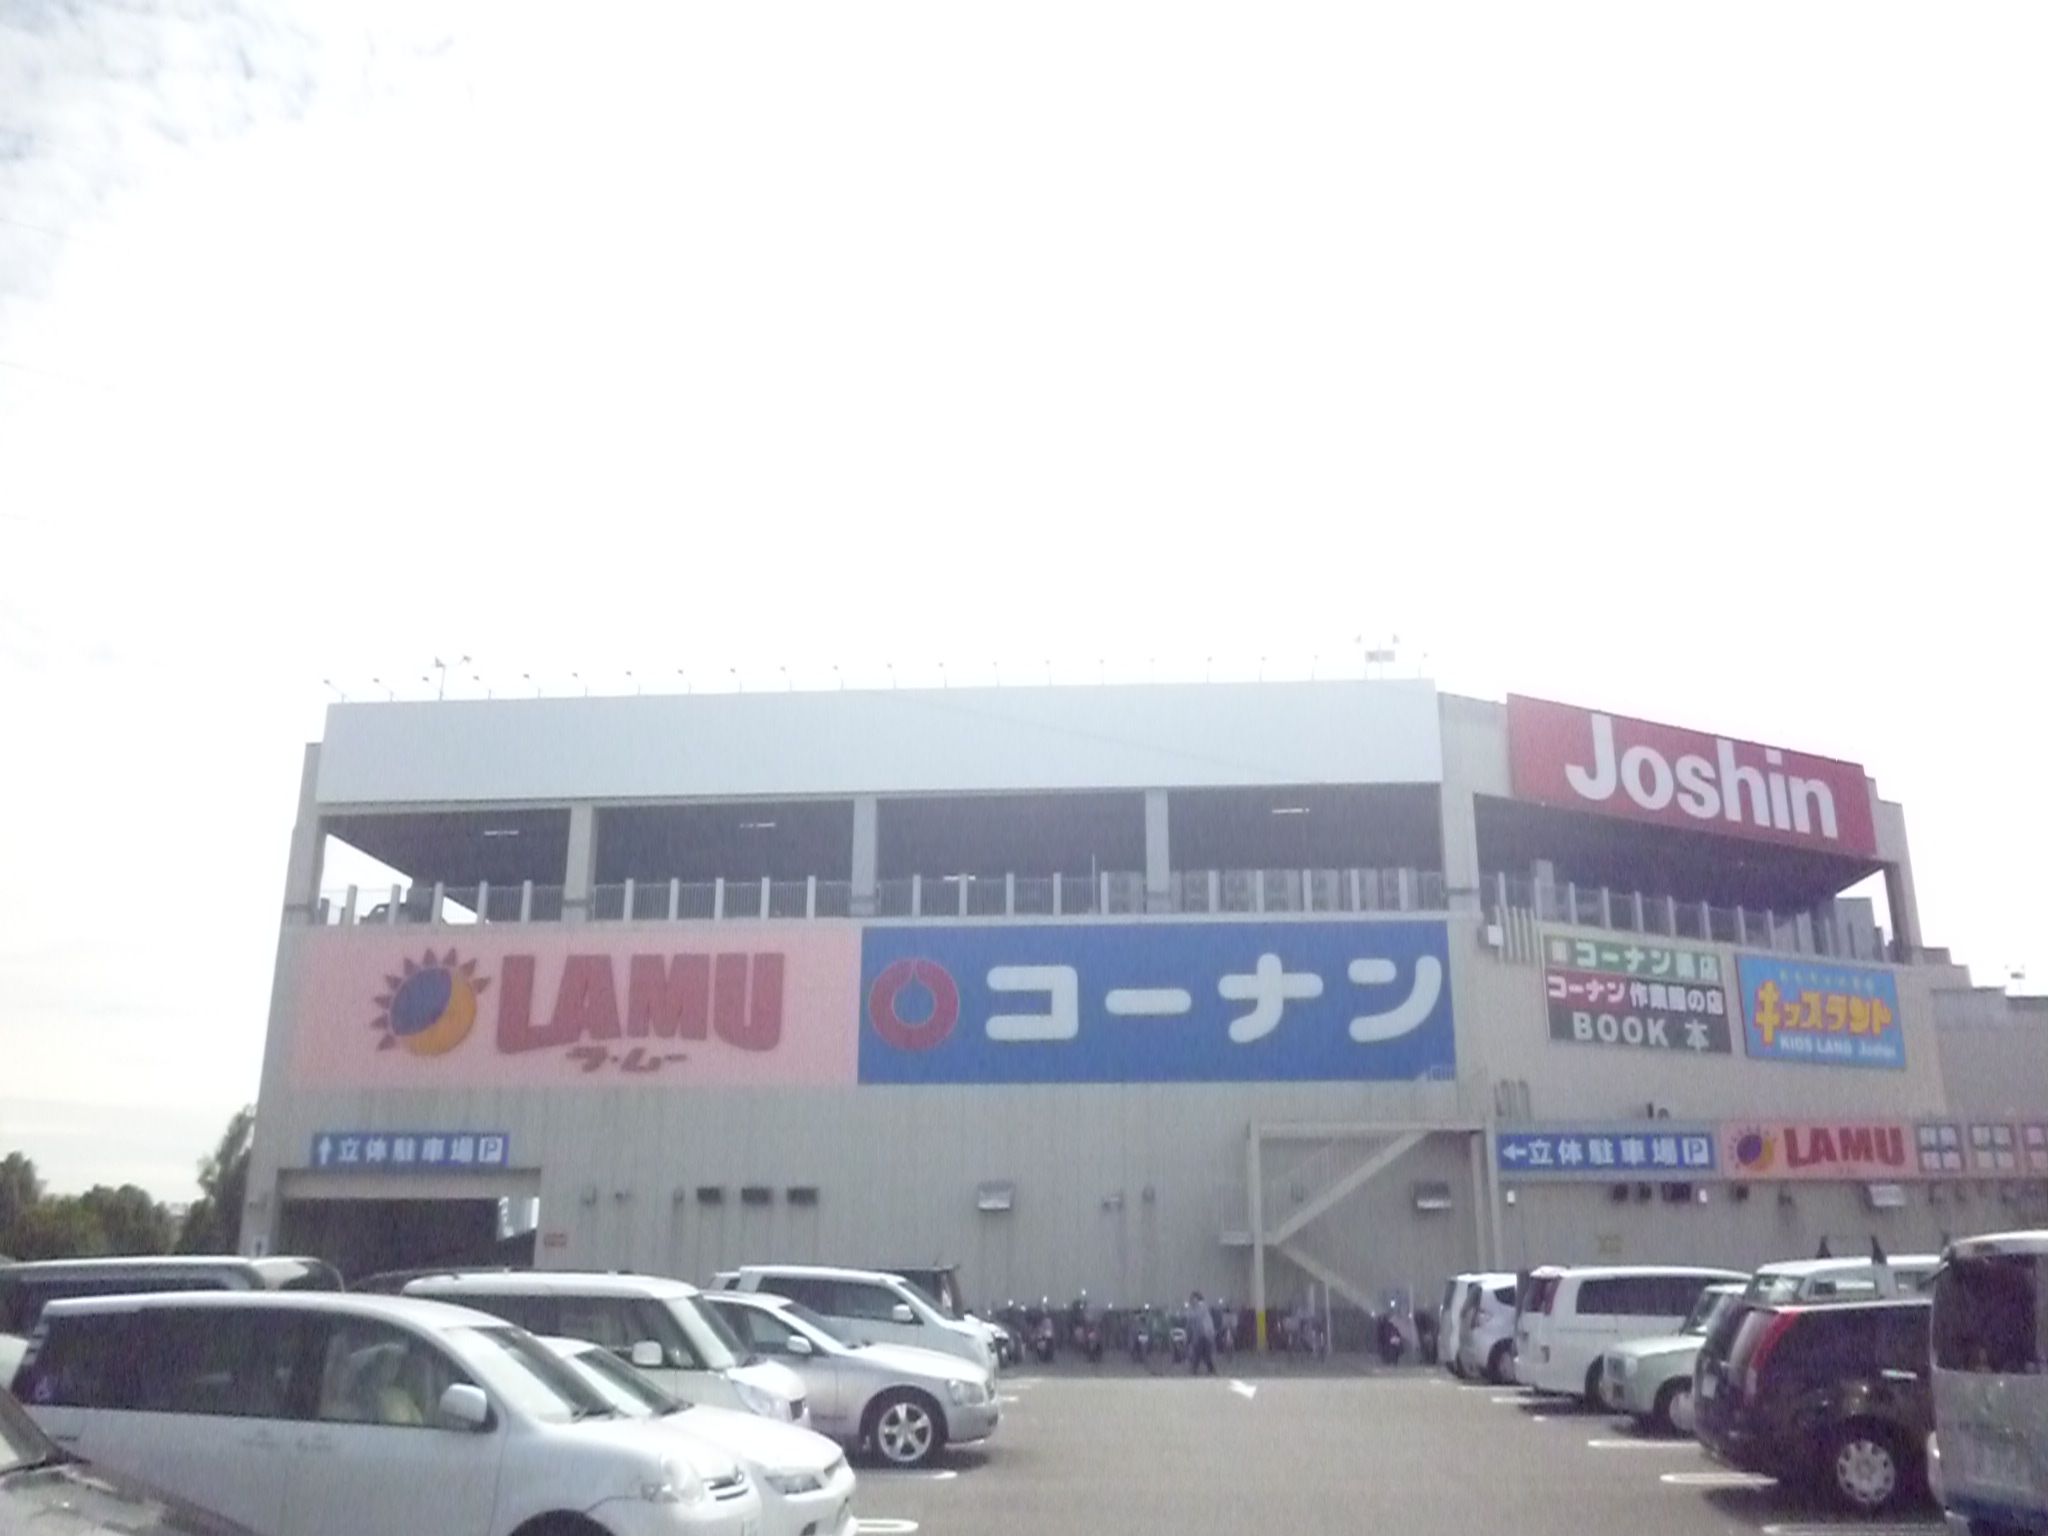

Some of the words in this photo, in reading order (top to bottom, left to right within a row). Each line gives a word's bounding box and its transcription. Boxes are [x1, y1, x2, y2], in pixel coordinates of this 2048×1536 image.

[1565, 711, 1839, 839] Joshin
[496, 952, 785, 1055] LAMU
[986, 953, 1442, 1043] コーナン
[1572, 1011, 1669, 1047] BOOK
[1684, 1018, 1710, 1050] 本
[1784, 1126, 1905, 1168] LAMU
